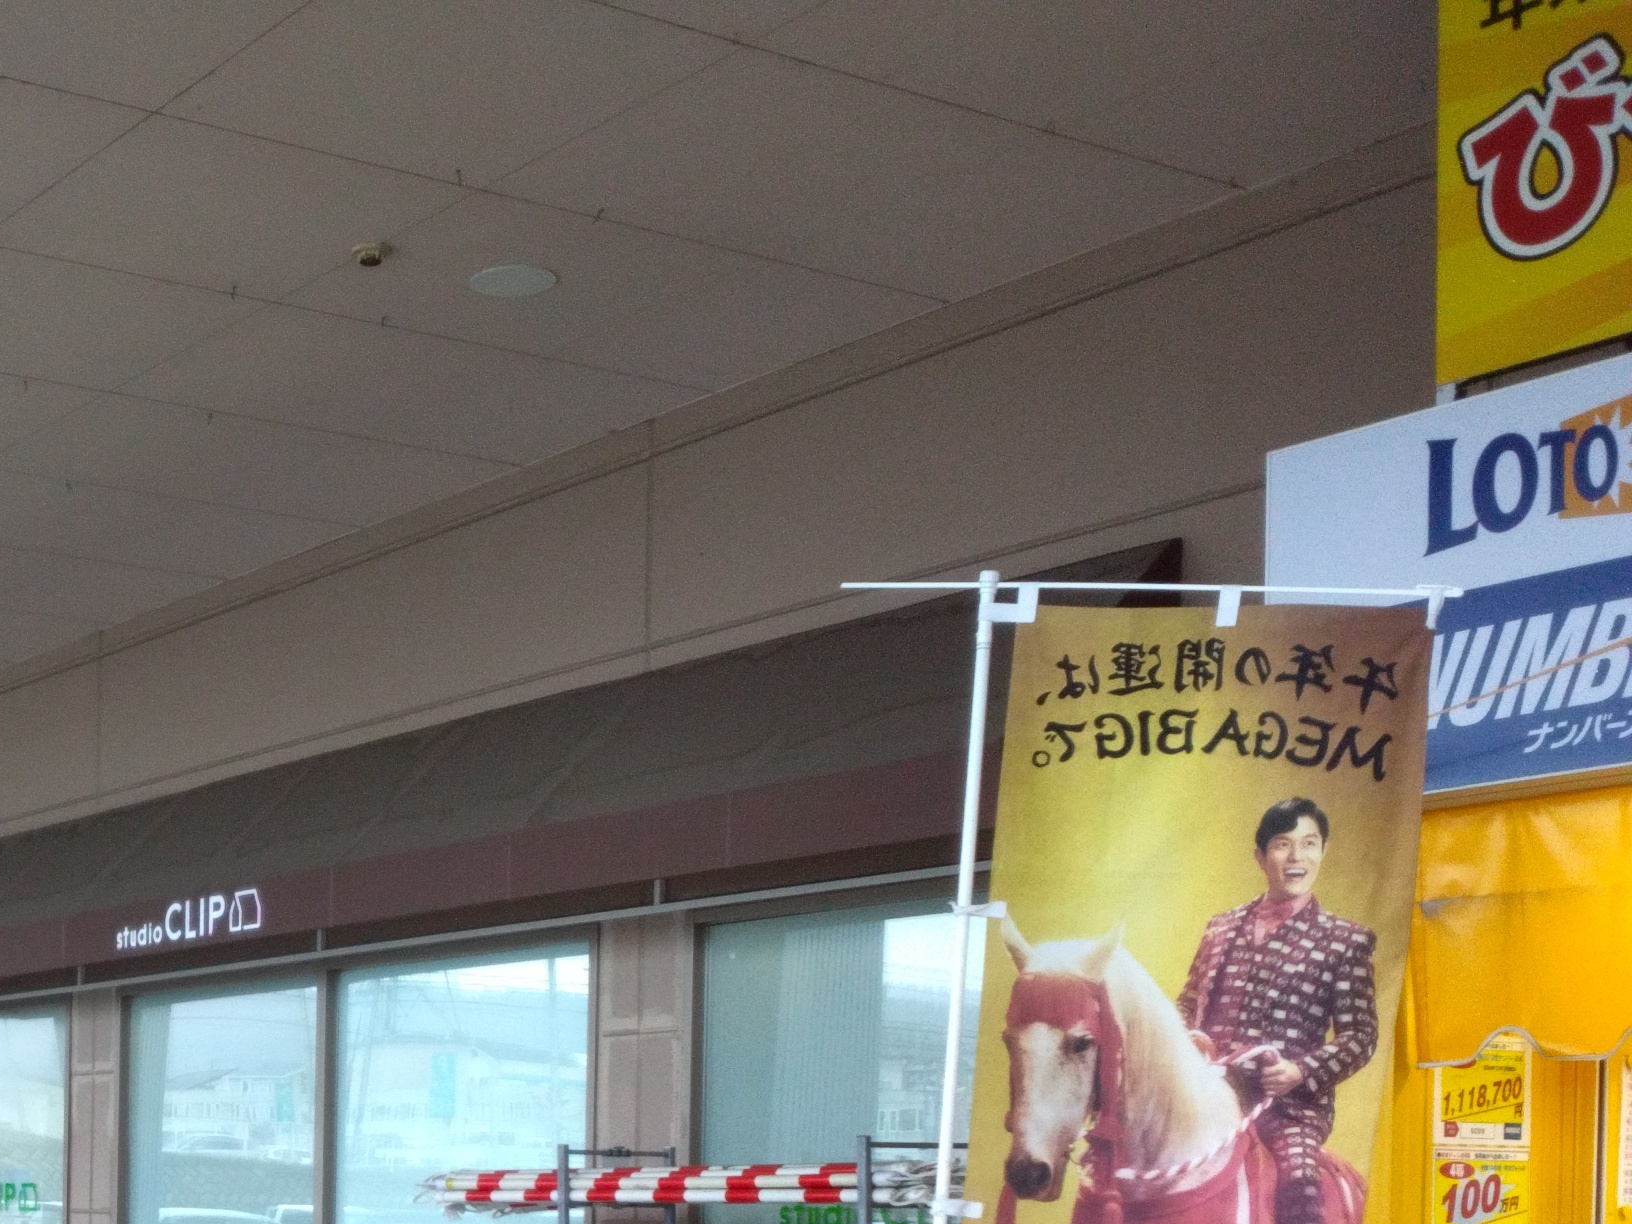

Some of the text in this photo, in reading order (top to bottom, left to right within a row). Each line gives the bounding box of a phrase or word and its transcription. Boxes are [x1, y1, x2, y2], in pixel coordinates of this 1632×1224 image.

[1457, 33, 1632, 262] び
[1423, 423, 1619, 557] LOTO
[1428, 597, 1632, 731] NUMB
[116, 894, 225, 949] studio CLIP
[1443, 1075, 1523, 1117] 1,118,700
